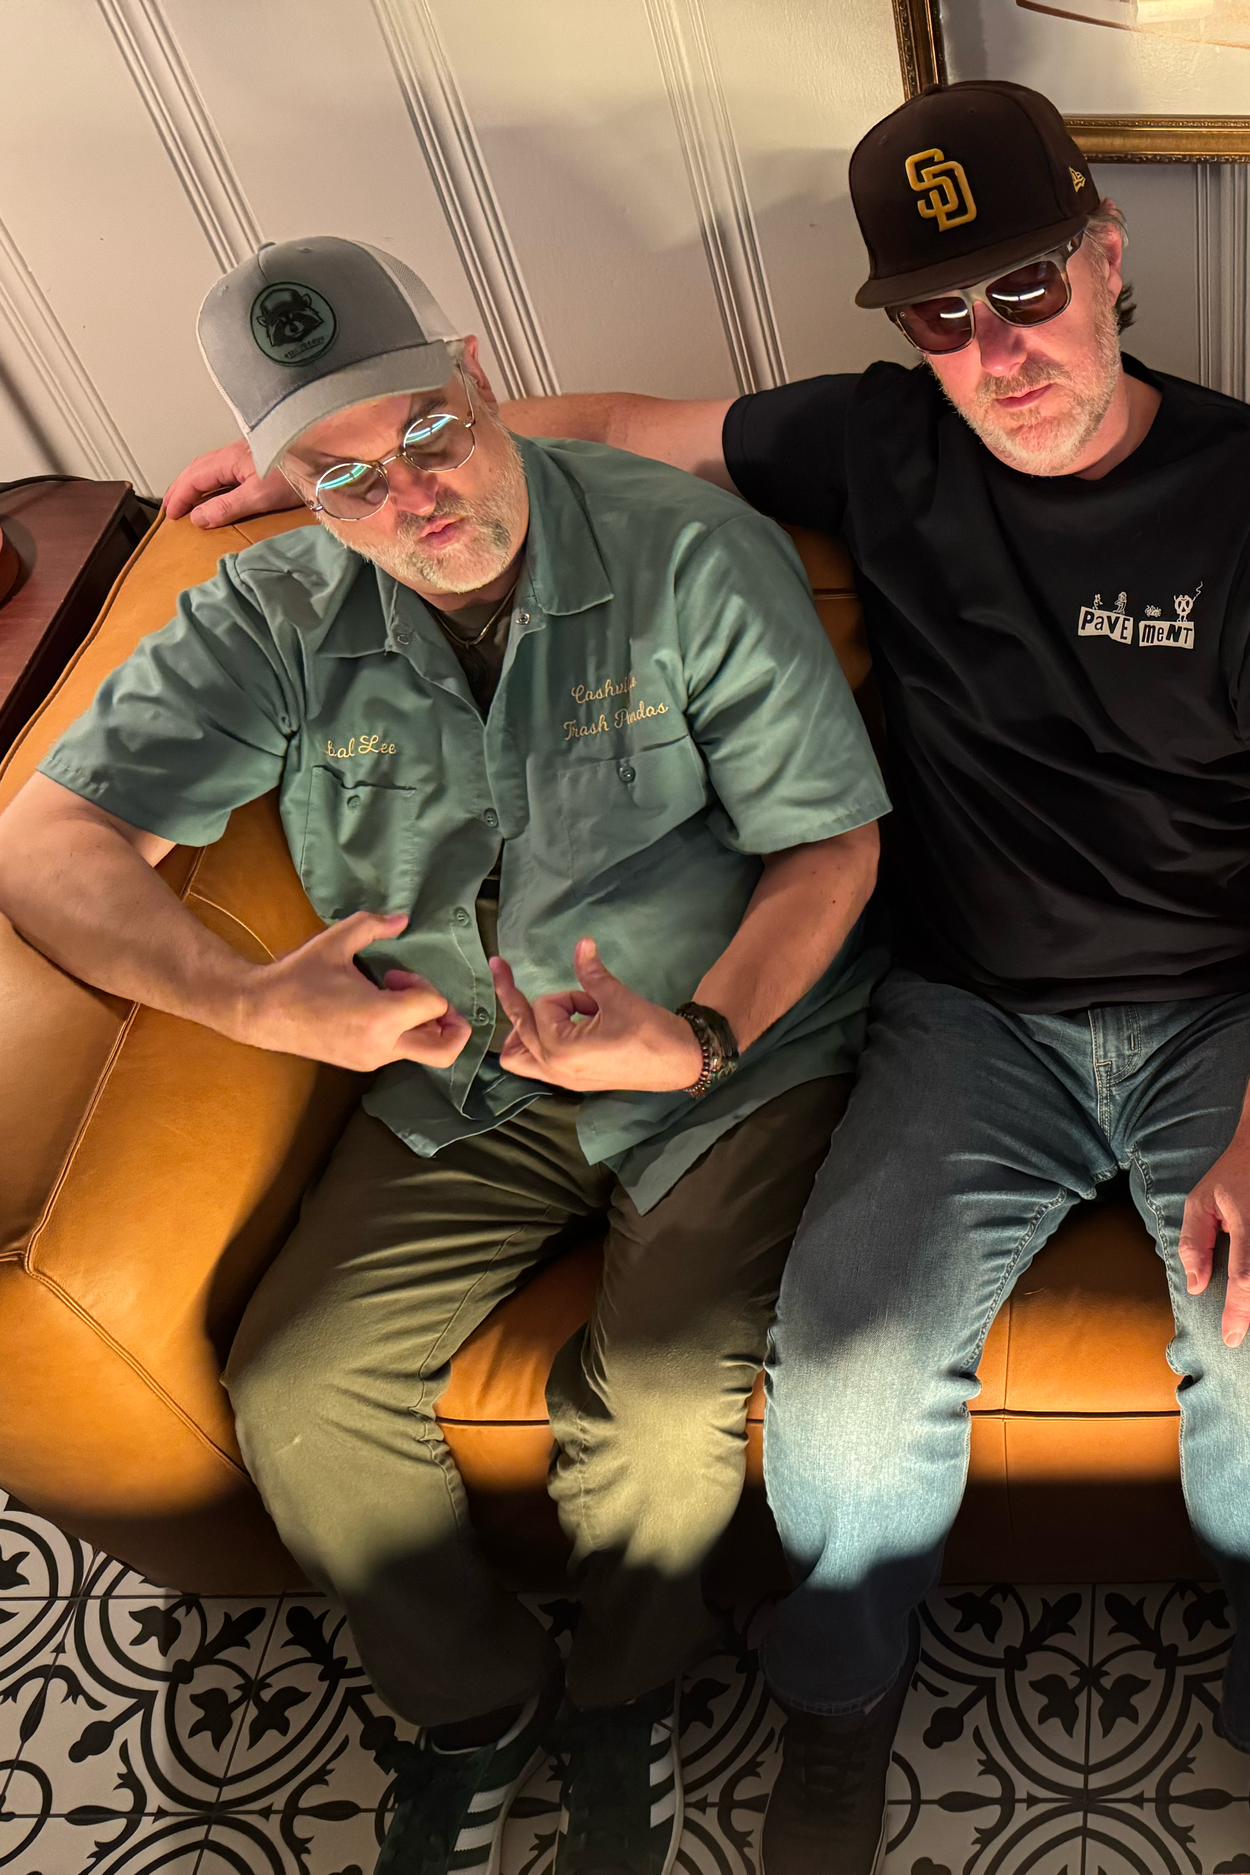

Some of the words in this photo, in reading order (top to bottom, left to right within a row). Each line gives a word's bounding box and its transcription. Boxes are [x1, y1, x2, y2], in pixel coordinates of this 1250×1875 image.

[904, 147, 978, 233] SD
[563, 714, 610, 741] Trash
[358, 734, 397, 755] Lee
